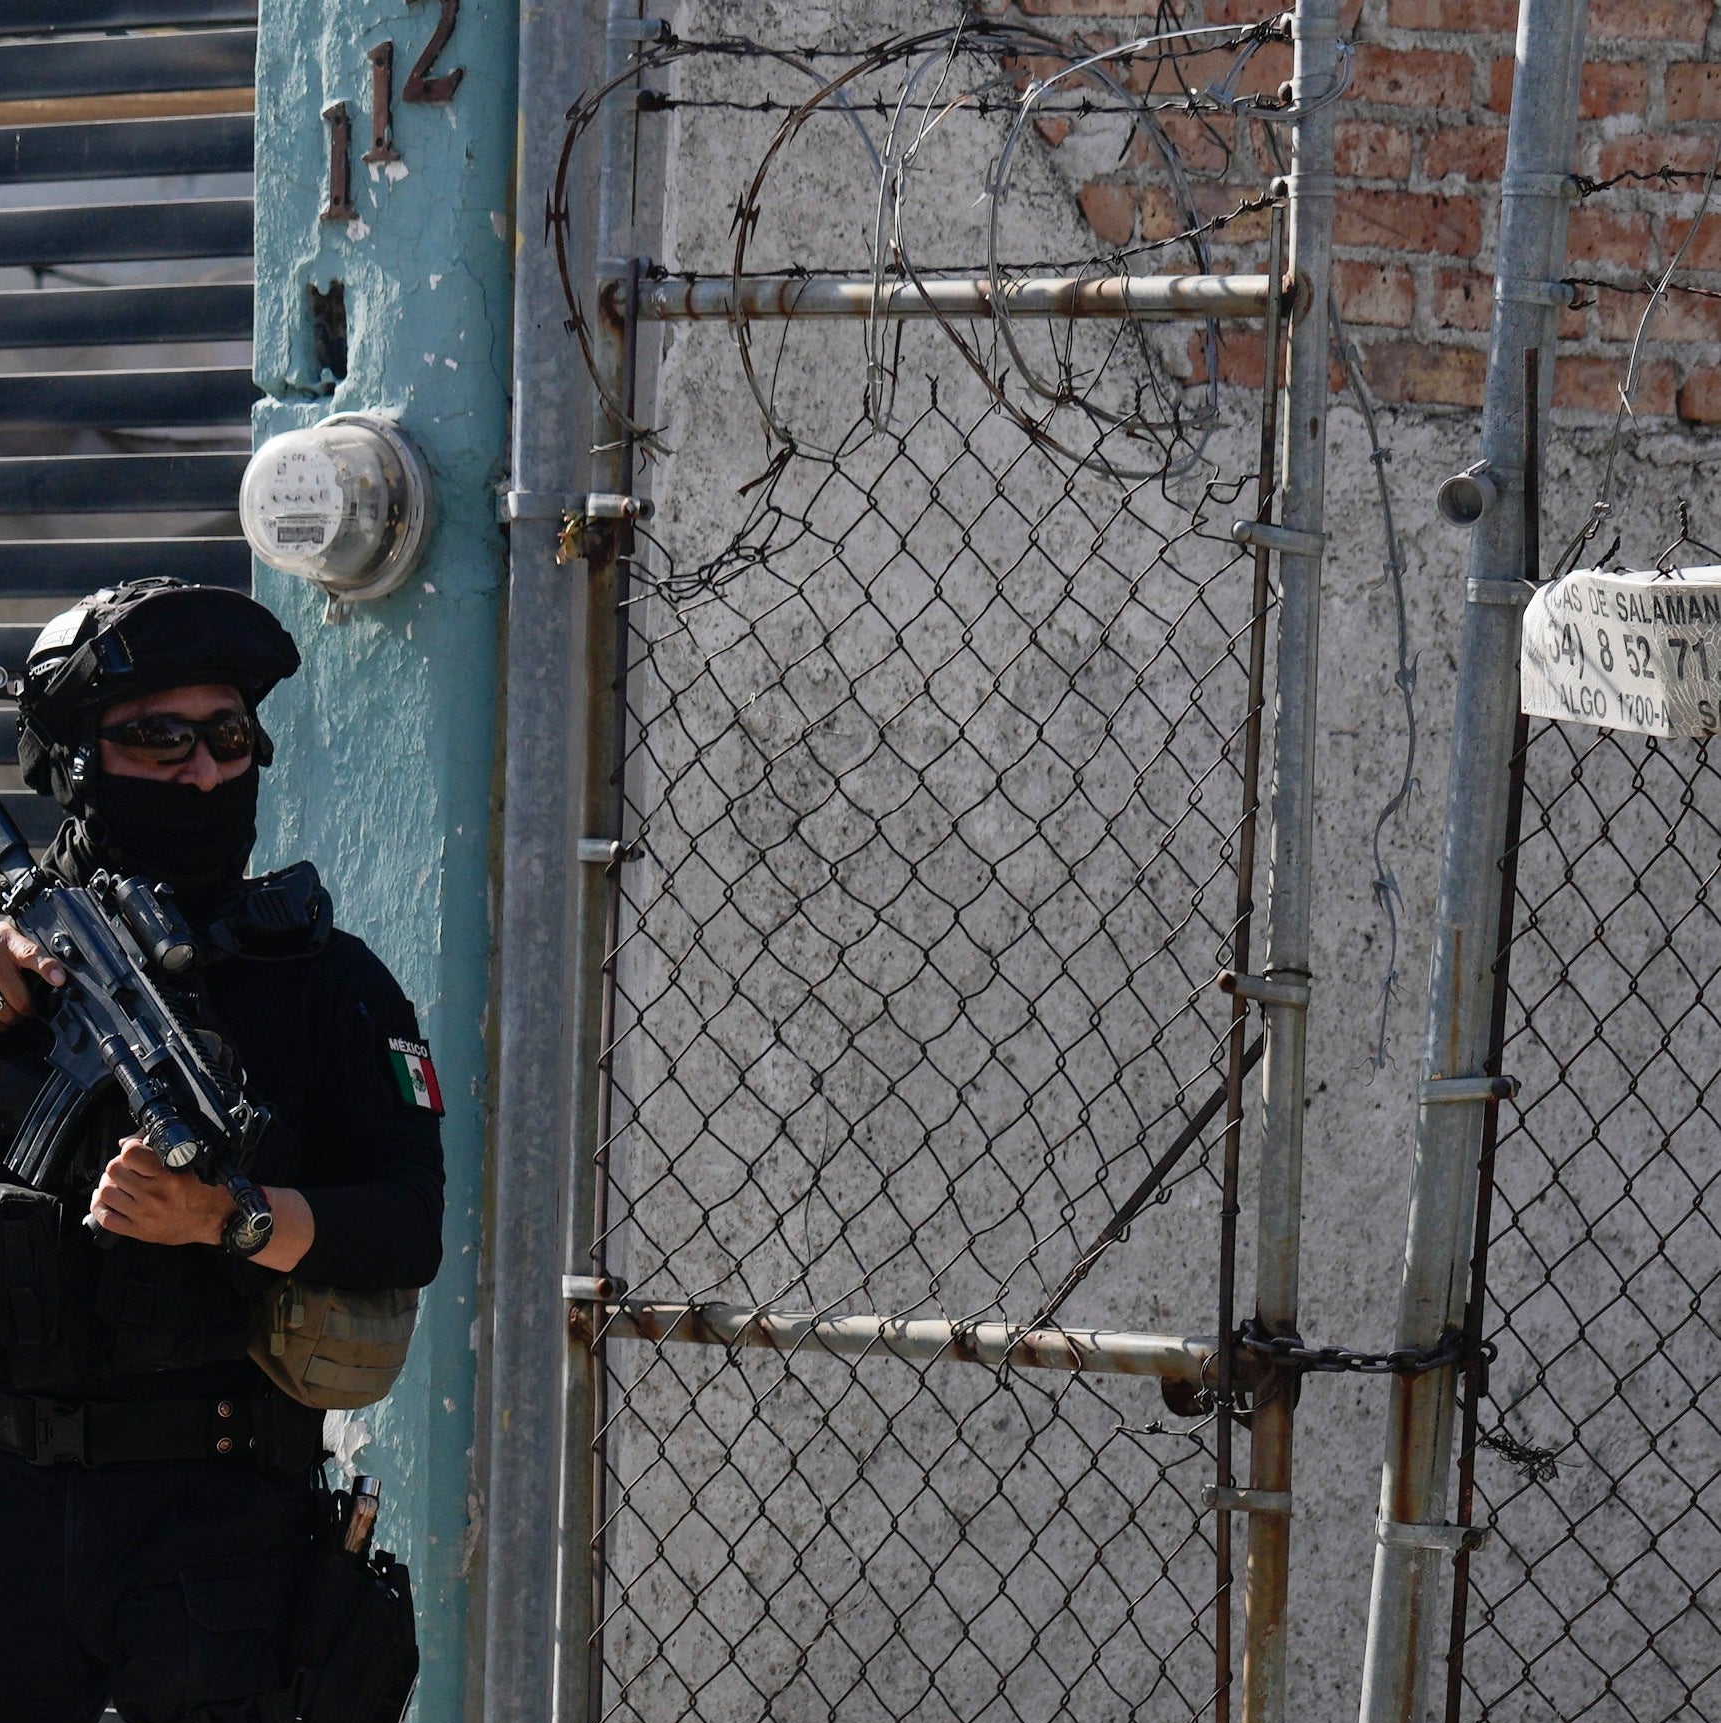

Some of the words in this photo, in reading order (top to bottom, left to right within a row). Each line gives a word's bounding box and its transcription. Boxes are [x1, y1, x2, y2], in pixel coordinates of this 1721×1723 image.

[320, 0, 466, 220] 112
[1588, 587, 1610, 618] DE
[1597, 628, 1614, 673] 8
[1623, 634, 1655, 680] 52
[1698, 700, 1721, 729] S
[388, 1037, 429, 1058] MÉXICO
